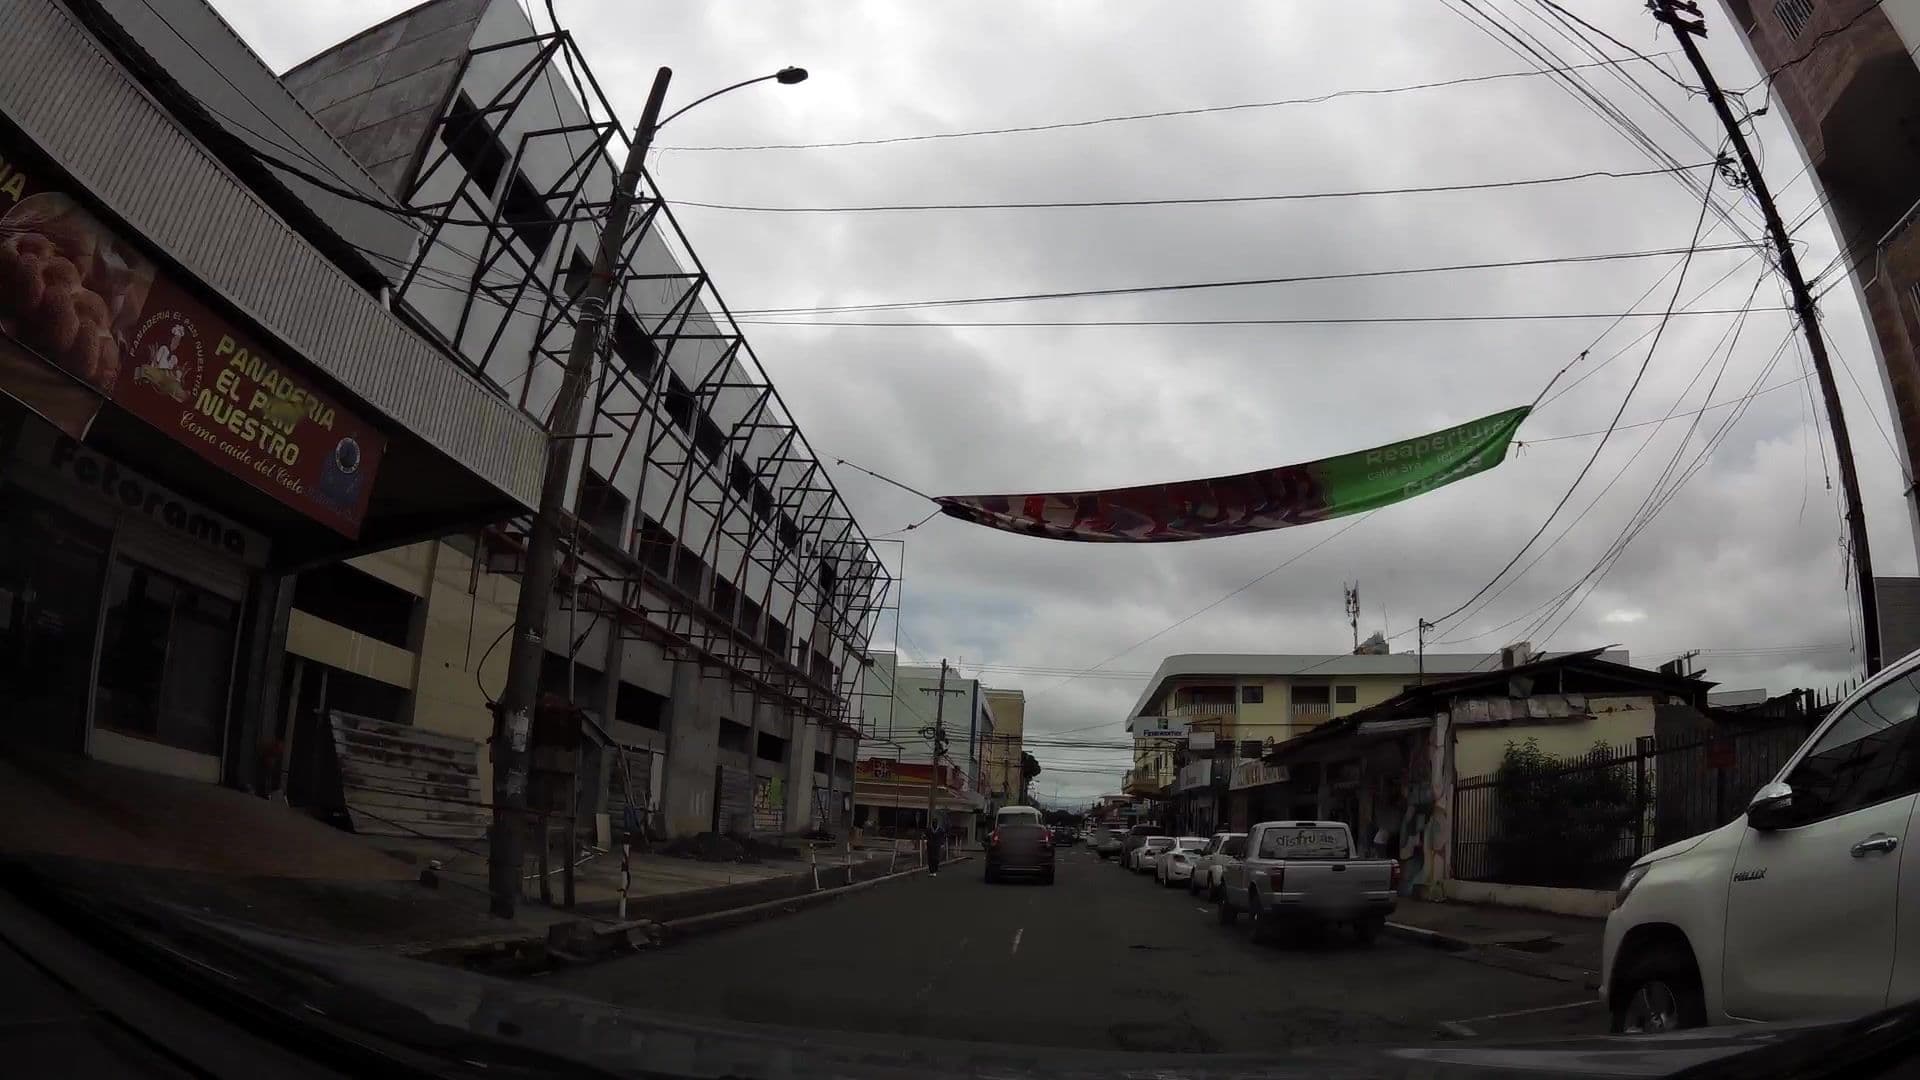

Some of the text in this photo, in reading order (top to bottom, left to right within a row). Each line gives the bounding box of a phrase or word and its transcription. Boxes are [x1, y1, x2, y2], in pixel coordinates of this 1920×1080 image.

[215, 334, 336, 432] PANADERIA
[216, 368, 241, 402] EL
[181, 411, 217, 444] Como
[253, 459, 276, 478] del
[195, 388, 300, 466] NUESTRO
[50, 436, 246, 557] Fotorama
